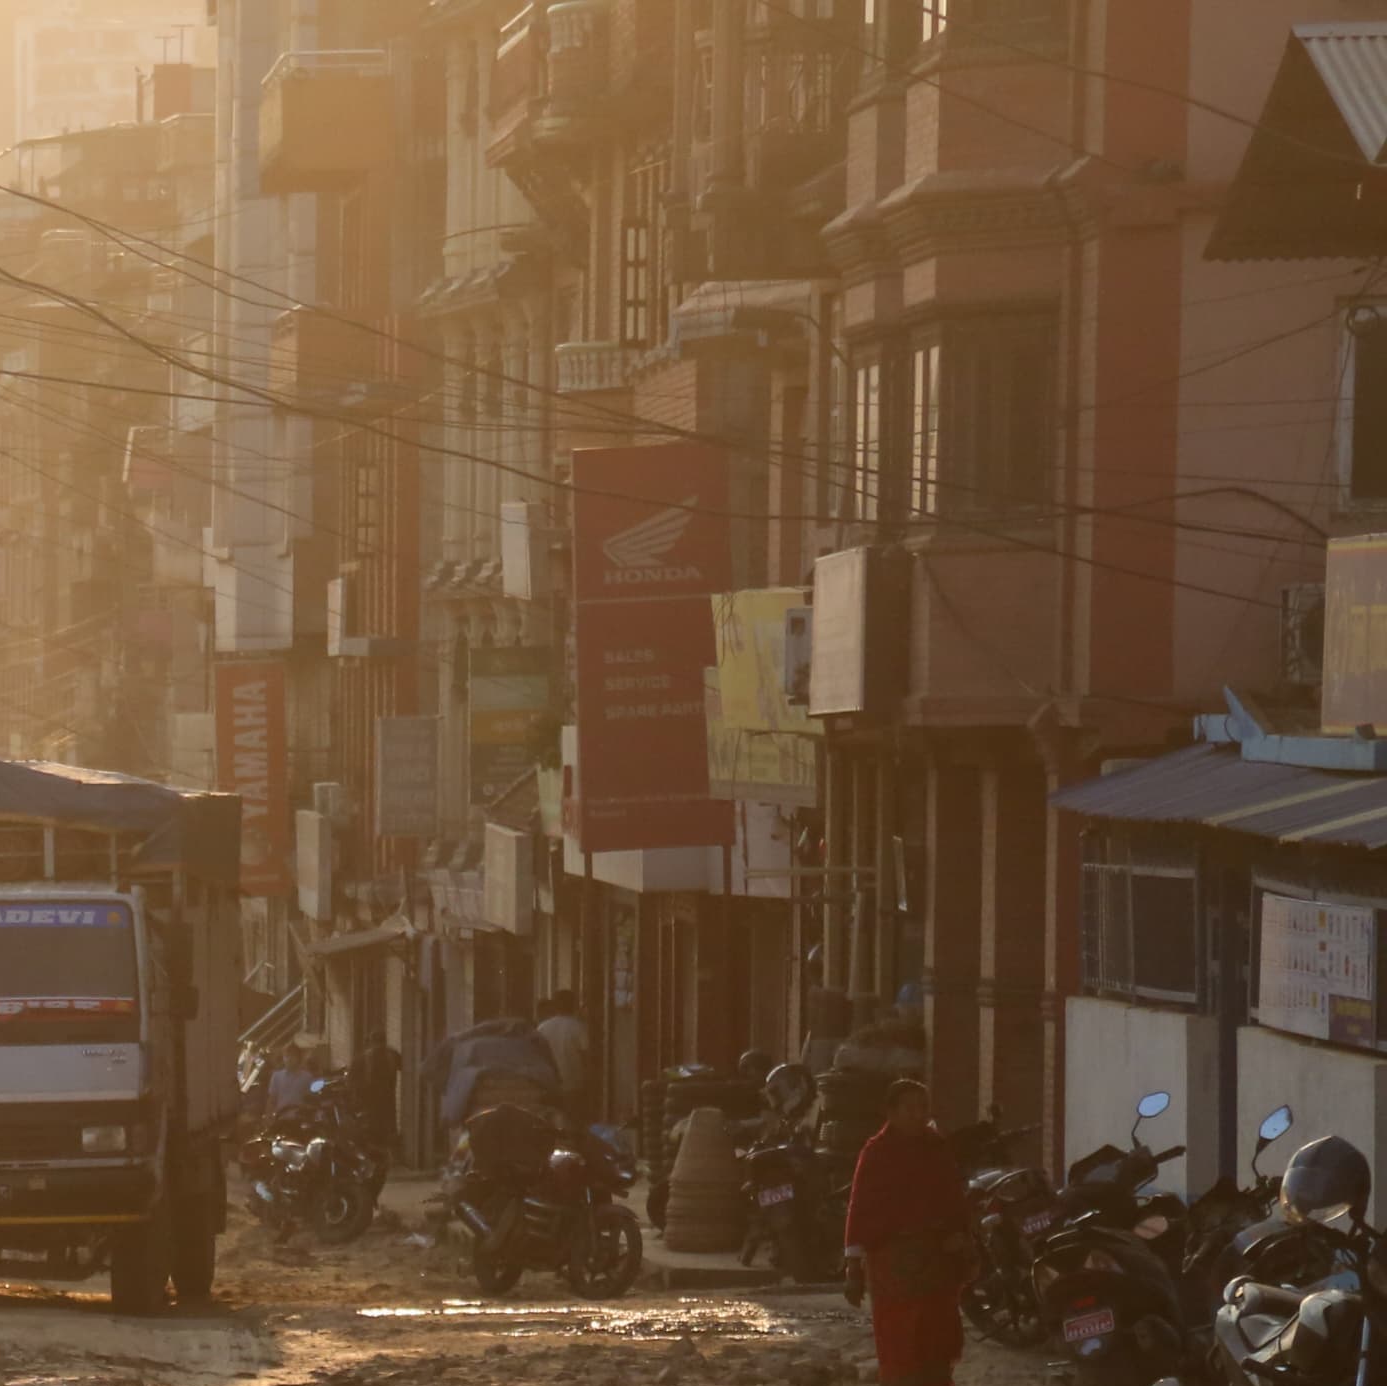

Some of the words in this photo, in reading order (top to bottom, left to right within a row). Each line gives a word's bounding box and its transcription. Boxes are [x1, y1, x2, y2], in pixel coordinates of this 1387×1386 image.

[603, 565, 701, 584] HONDA
[604, 648, 655, 664] SALES
[605, 674, 671, 691] SERVICE
[661, 701, 705, 717] PART
[233, 680, 267, 820] YAMAHA
